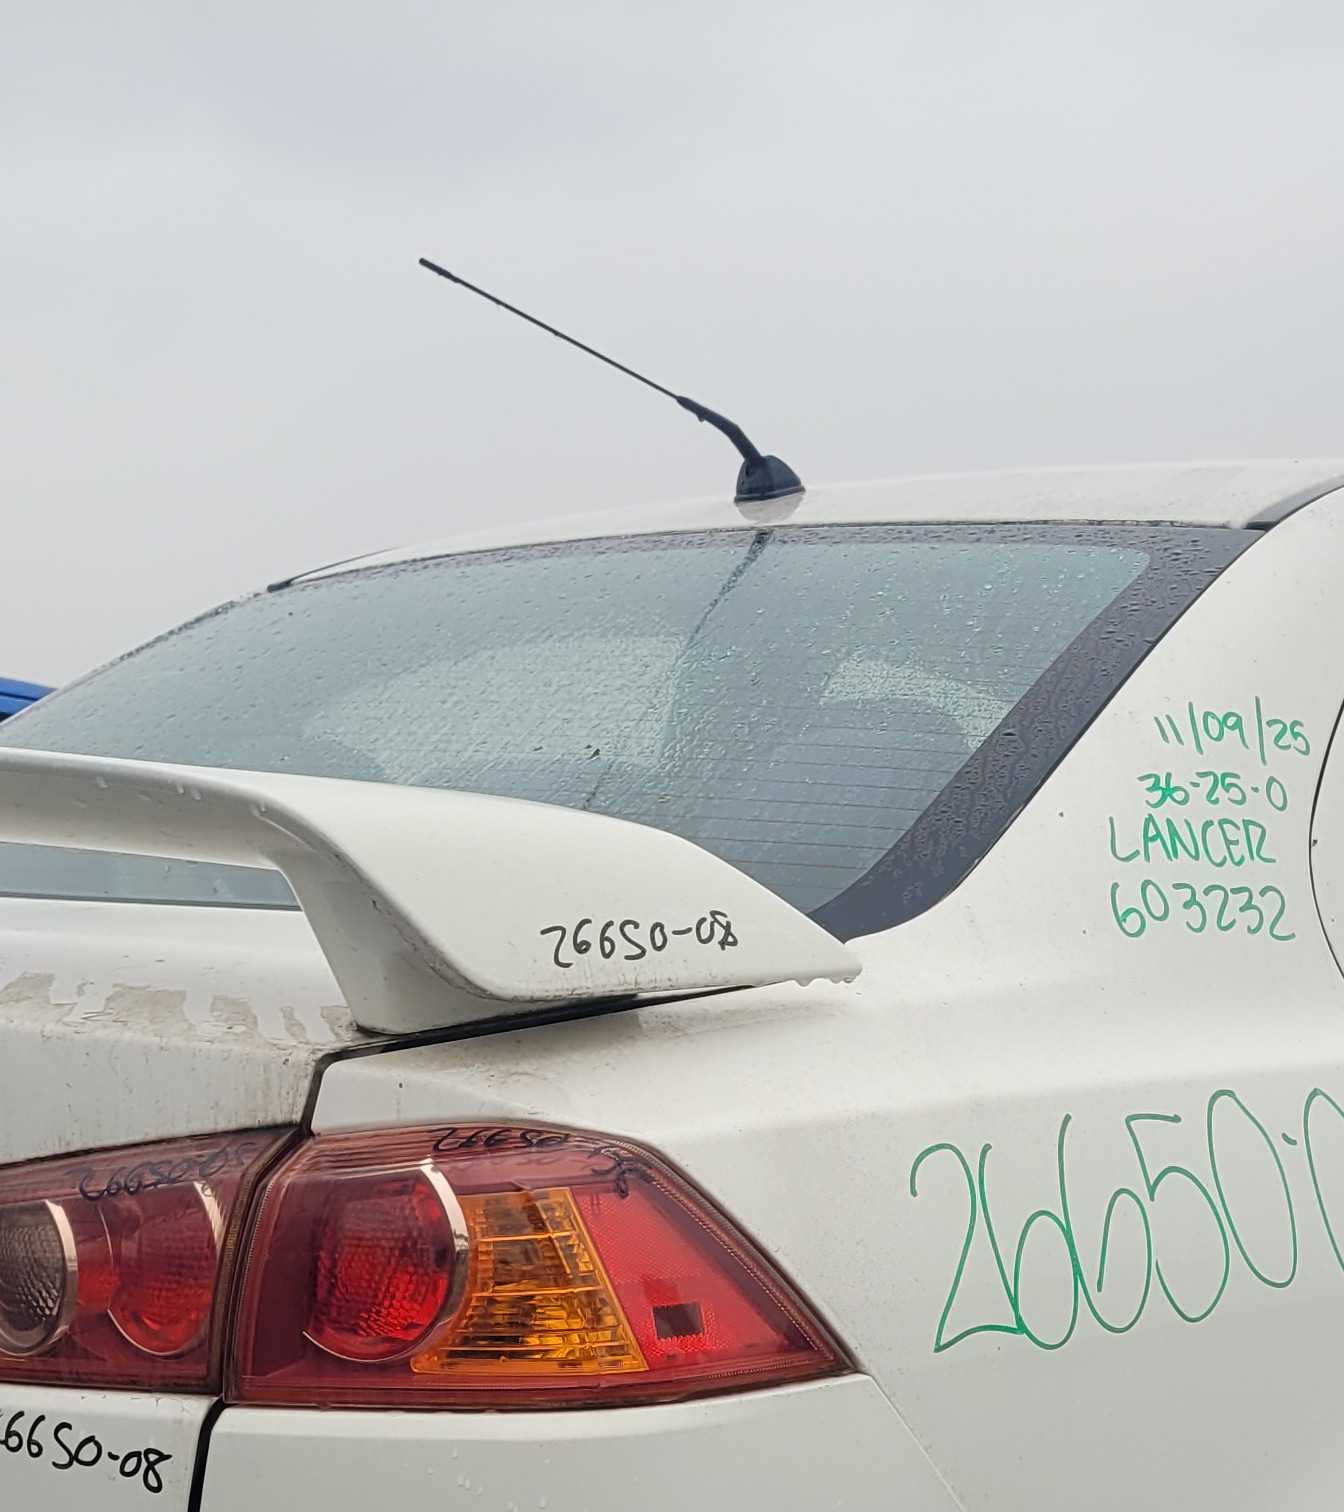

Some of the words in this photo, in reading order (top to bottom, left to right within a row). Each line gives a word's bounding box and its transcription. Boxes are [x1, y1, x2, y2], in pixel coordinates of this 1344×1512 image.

[1153, 695, 1311, 766] 11/09/25
[1108, 812, 1277, 868] LANCER
[1109, 878, 1297, 942] 603232
